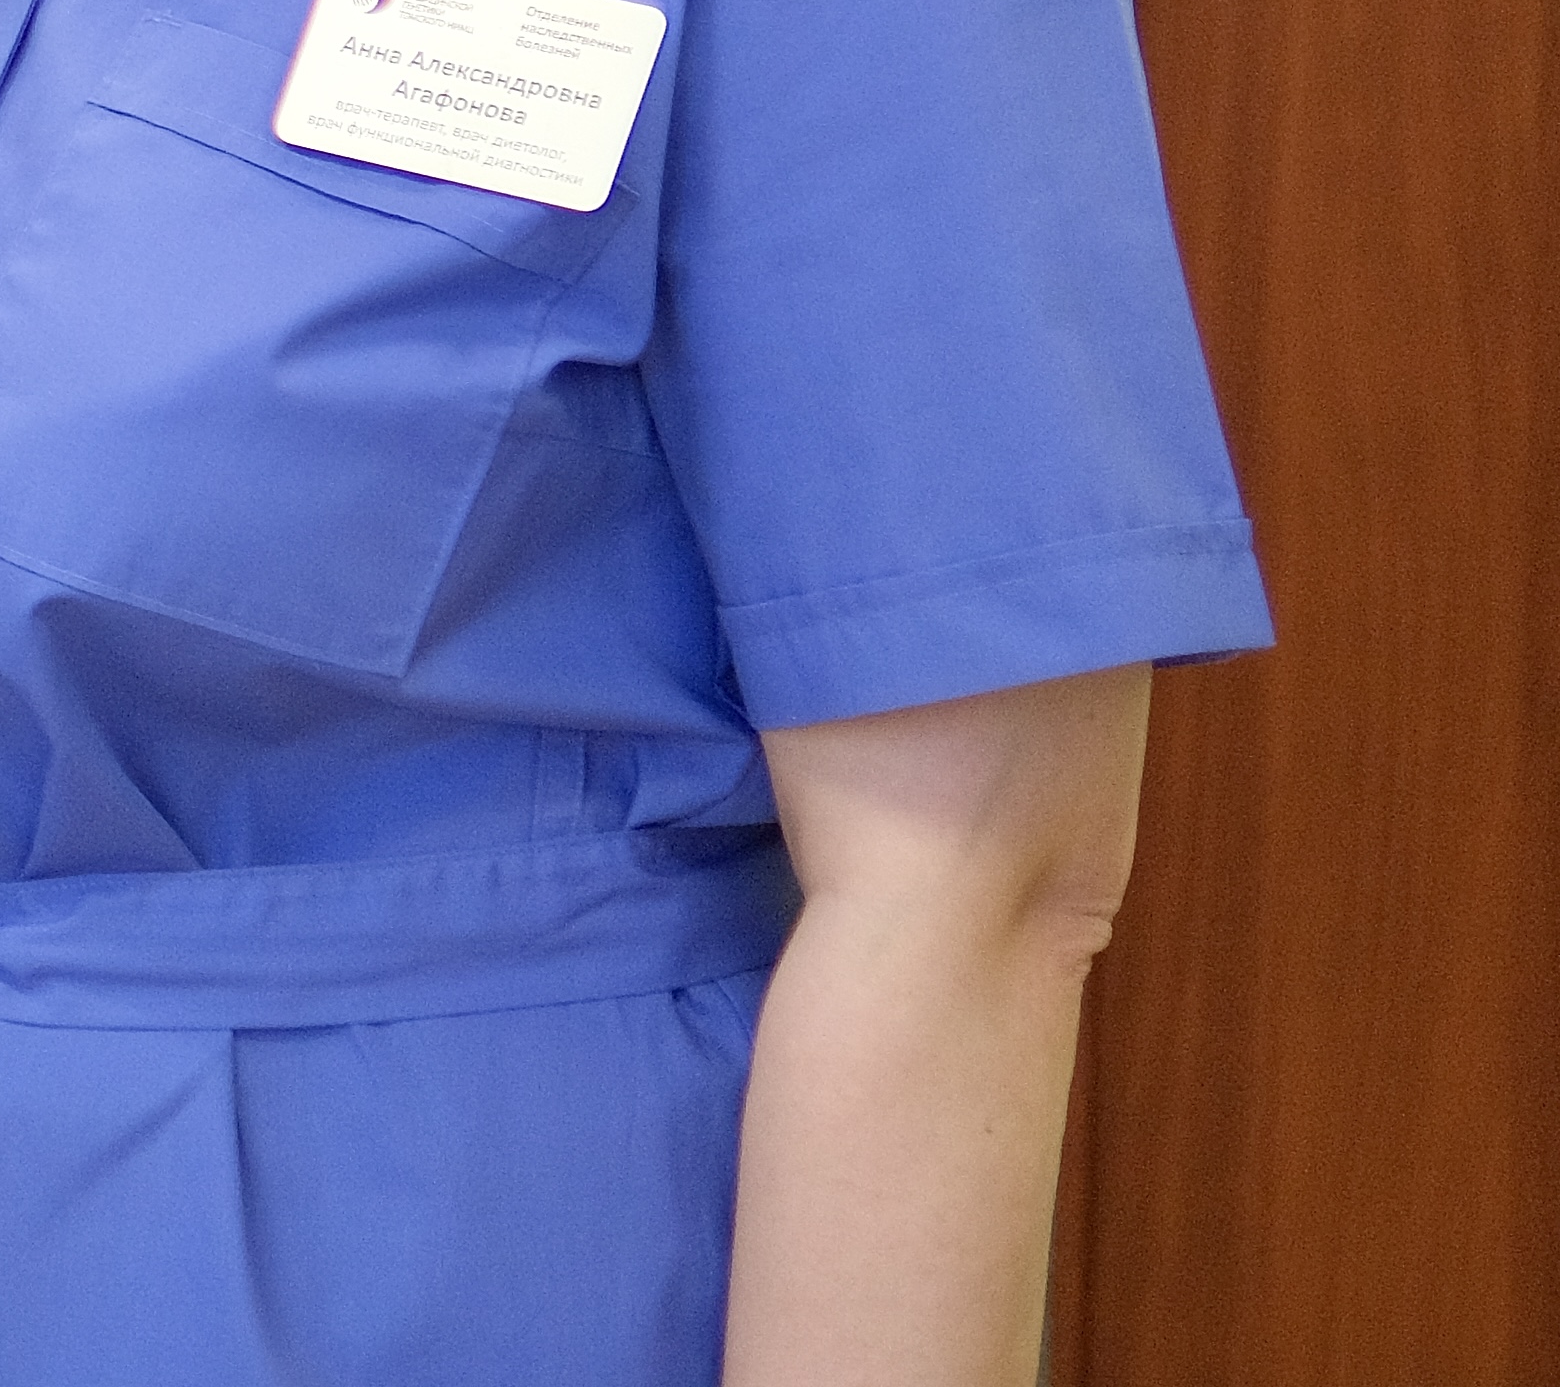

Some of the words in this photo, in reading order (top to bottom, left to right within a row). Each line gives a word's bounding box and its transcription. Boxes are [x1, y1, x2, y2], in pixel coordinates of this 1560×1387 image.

[526, 6, 600, 31] Отделение
[515, 36, 581, 60] болезней
[521, 24, 634, 54] наследственных
[339, 35, 403, 67] Анна
[407, 50, 603, 111] Александровна
[391, 79, 528, 126] Агафонова
[307, 114, 345, 138] врач
[346, 119, 481, 163] функциональной
[482, 153, 584, 187] диагностики
[452, 126, 489, 148] врач
